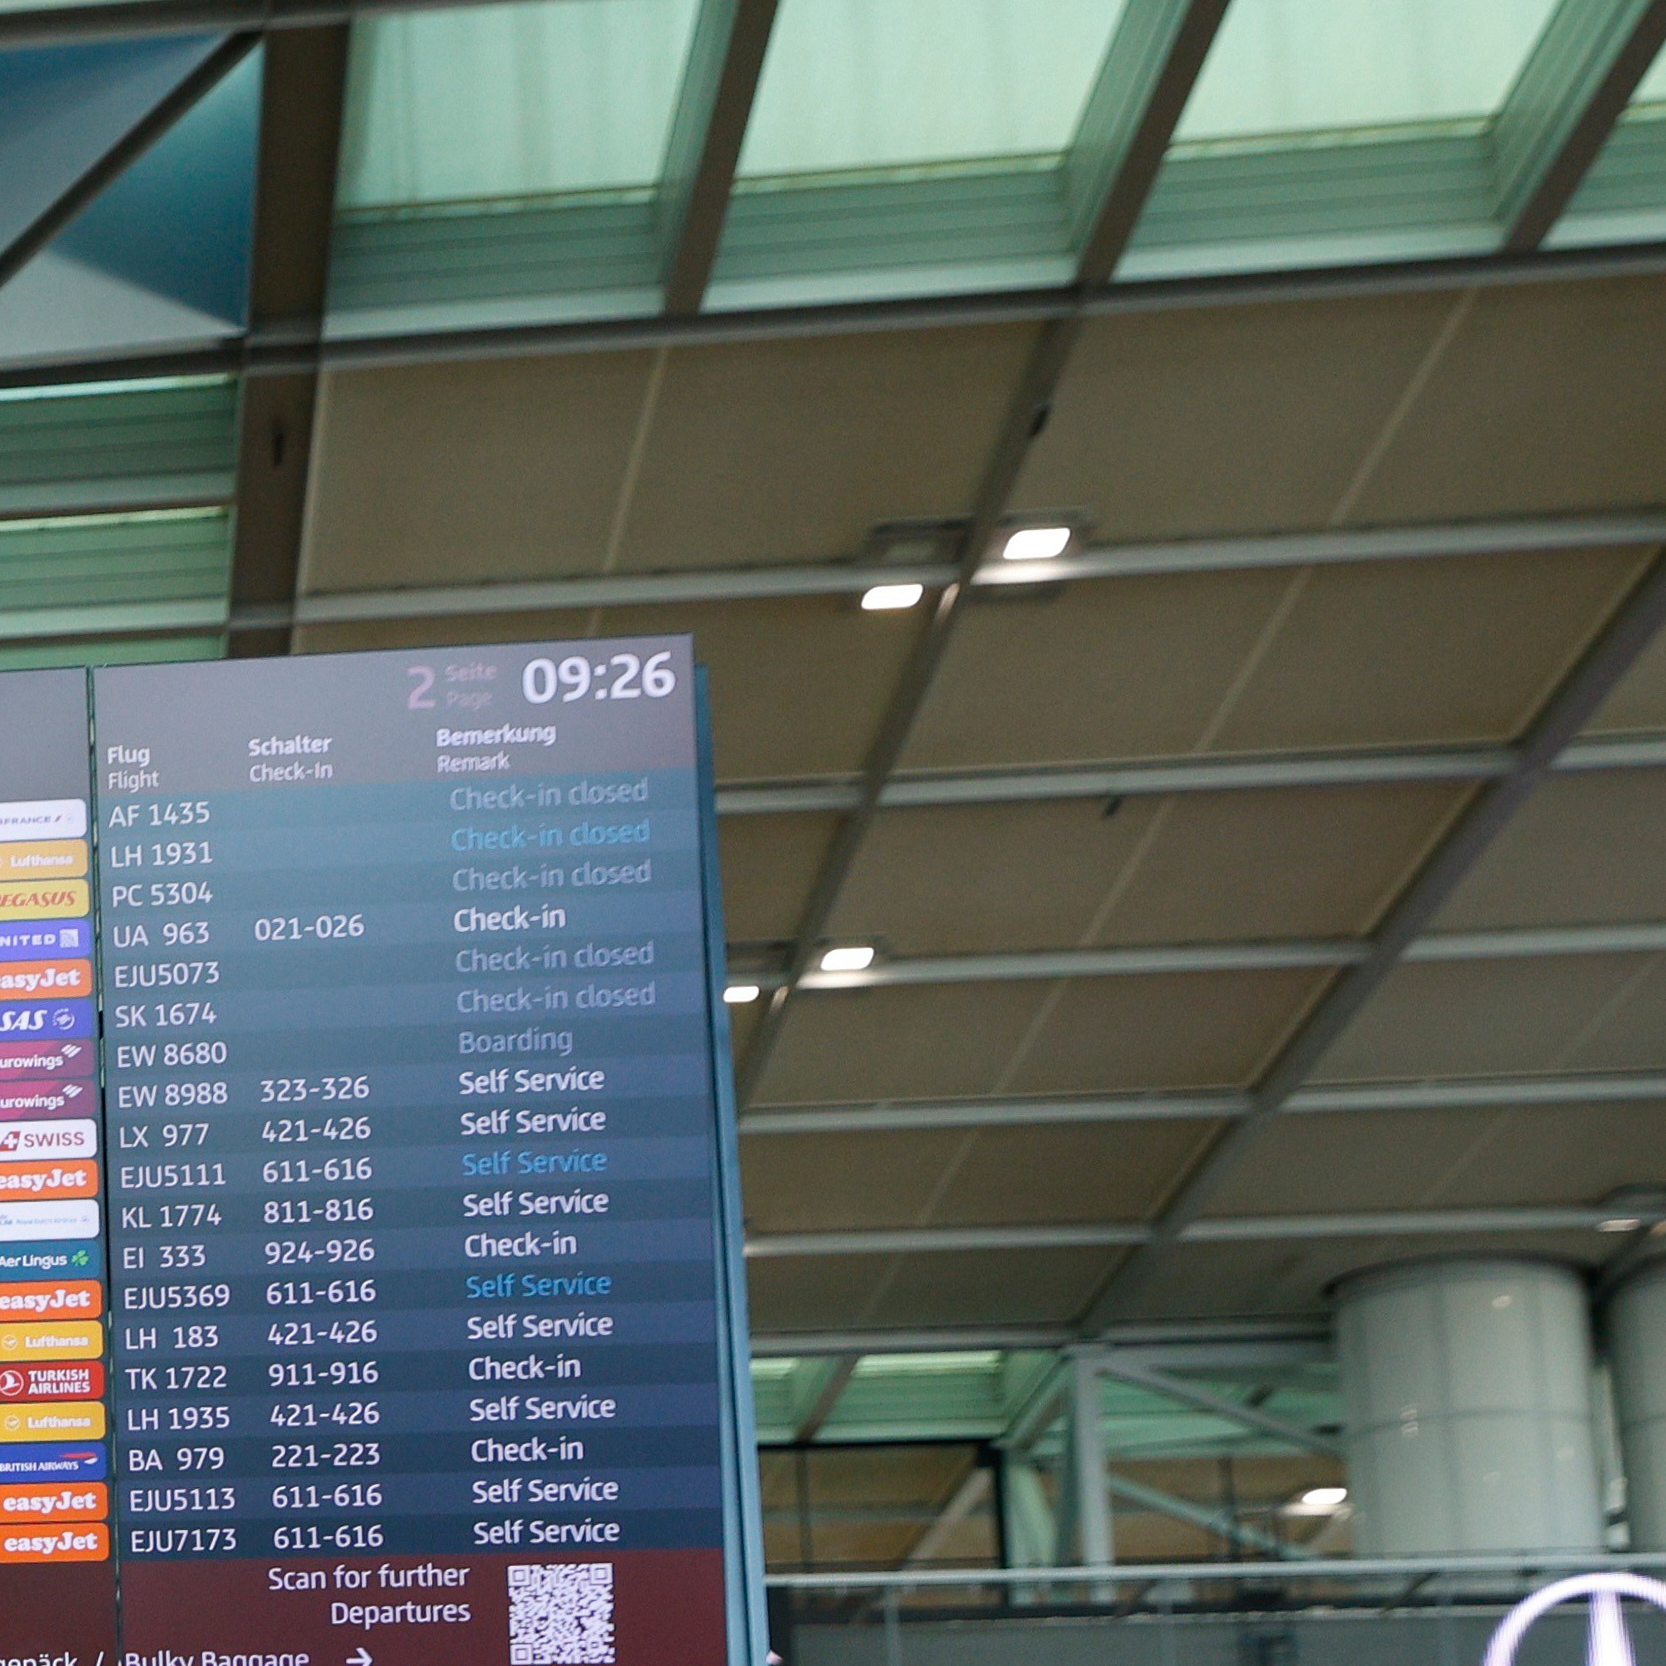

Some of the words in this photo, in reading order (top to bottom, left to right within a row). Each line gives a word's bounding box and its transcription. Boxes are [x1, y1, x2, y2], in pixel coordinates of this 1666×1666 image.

[523, 652, 675, 703] 09:26
[437, 724, 556, 746] Bemerkung
[255, 914, 364, 940] 021-026
[454, 904, 565, 932] Check-in
[114, 925, 148, 947] UA
[163, 922, 209, 945] 963
[261, 1076, 369, 1102] 323-326
[460, 1069, 508, 1094] Self
[515, 1066, 604, 1092] Service
[265, 1239, 374, 1264] 924-926
[29, 1369, 88, 1381] TURKISH
[29, 1382, 90, 1394] AIRLINES
[269, 1568, 326, 1590] Scan
[333, 1565, 371, 1588] for
[378, 1563, 470, 1587] further
[332, 1601, 470, 1630] Departures
